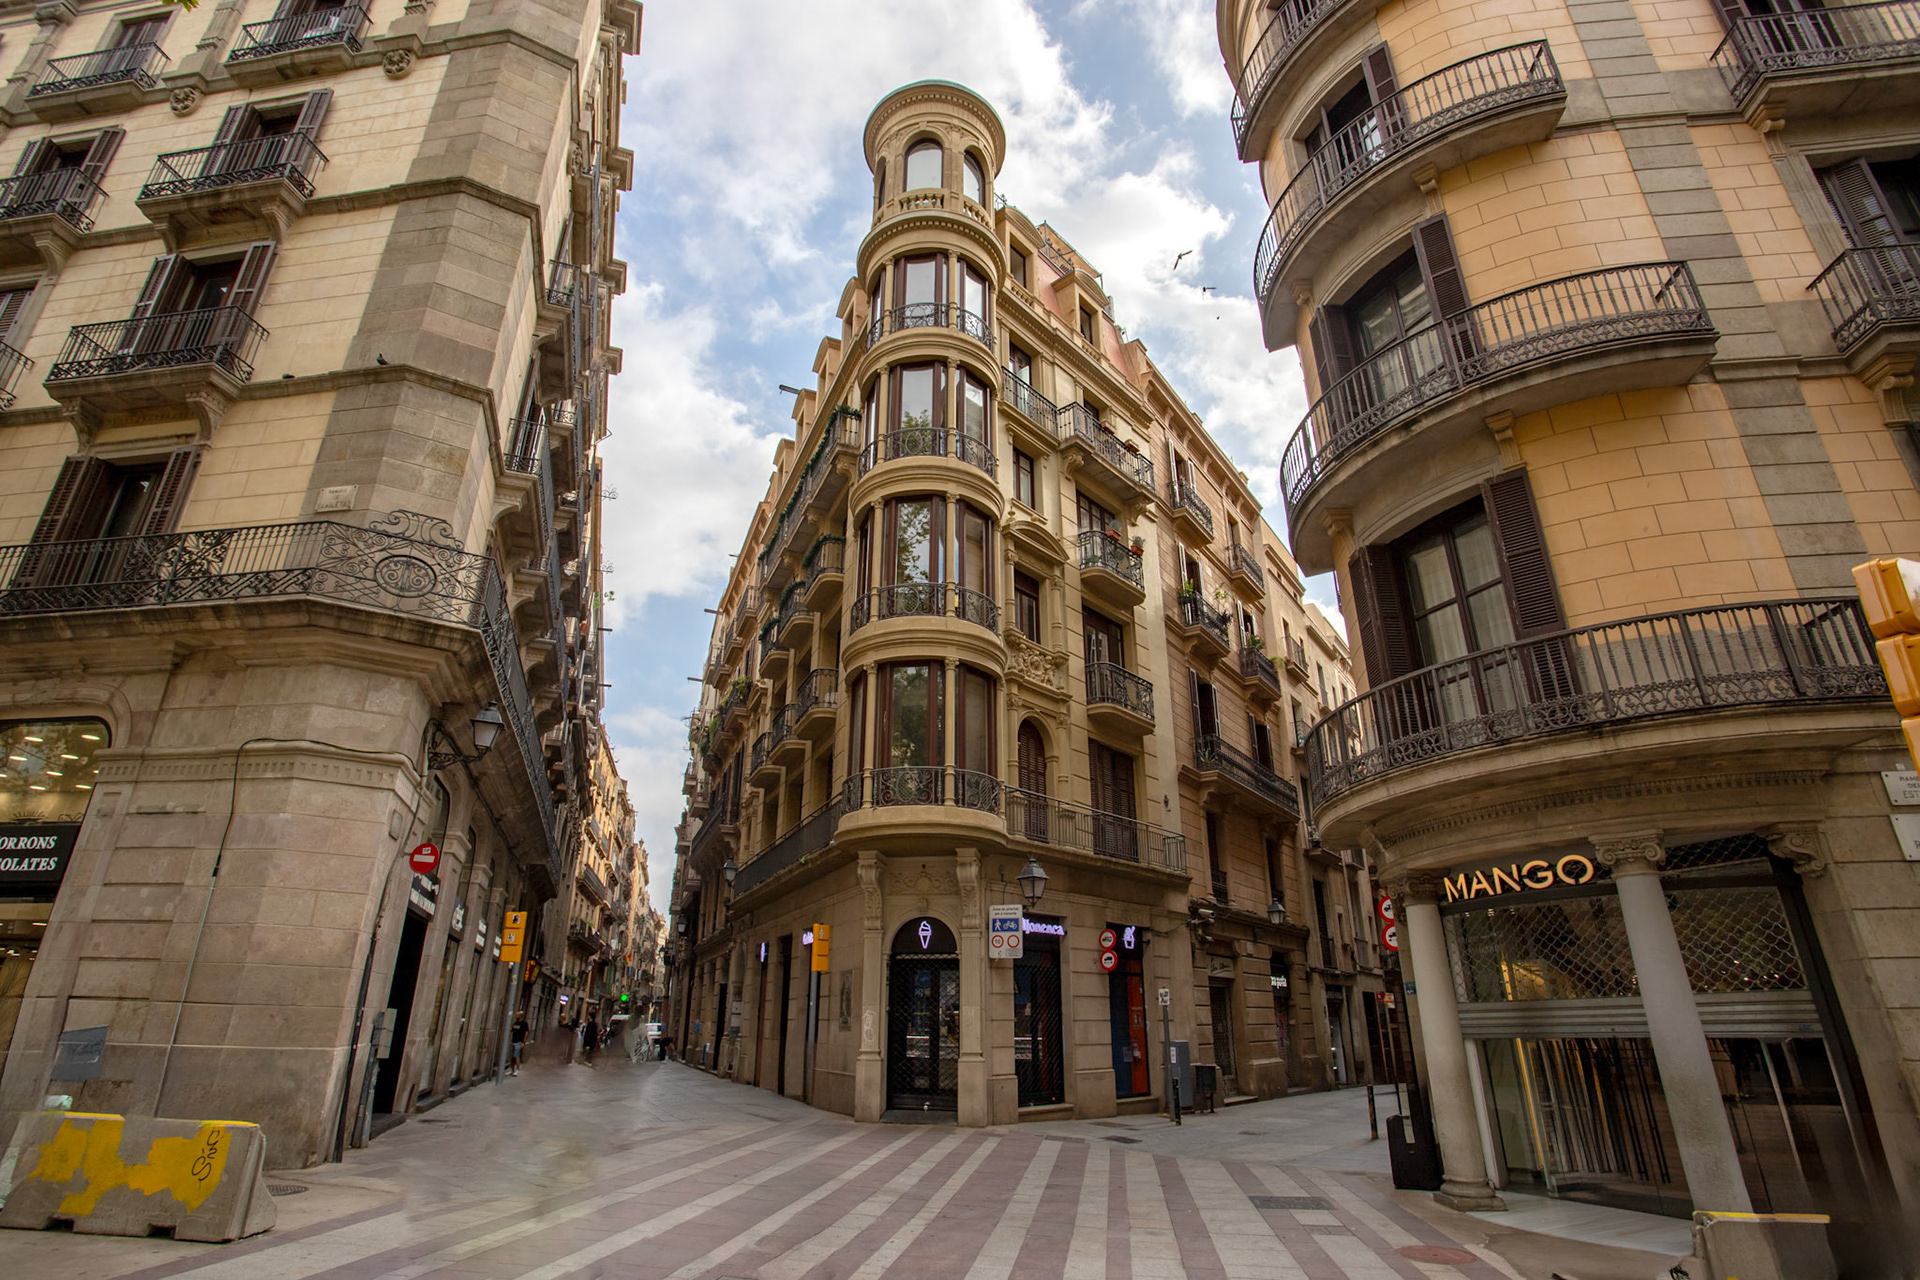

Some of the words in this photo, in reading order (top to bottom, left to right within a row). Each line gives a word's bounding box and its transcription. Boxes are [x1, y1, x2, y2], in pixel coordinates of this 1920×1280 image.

[0, 836, 58, 849] ORRONS
[0, 857, 59, 871] OLATES
[1443, 854, 1595, 904] MANGO
